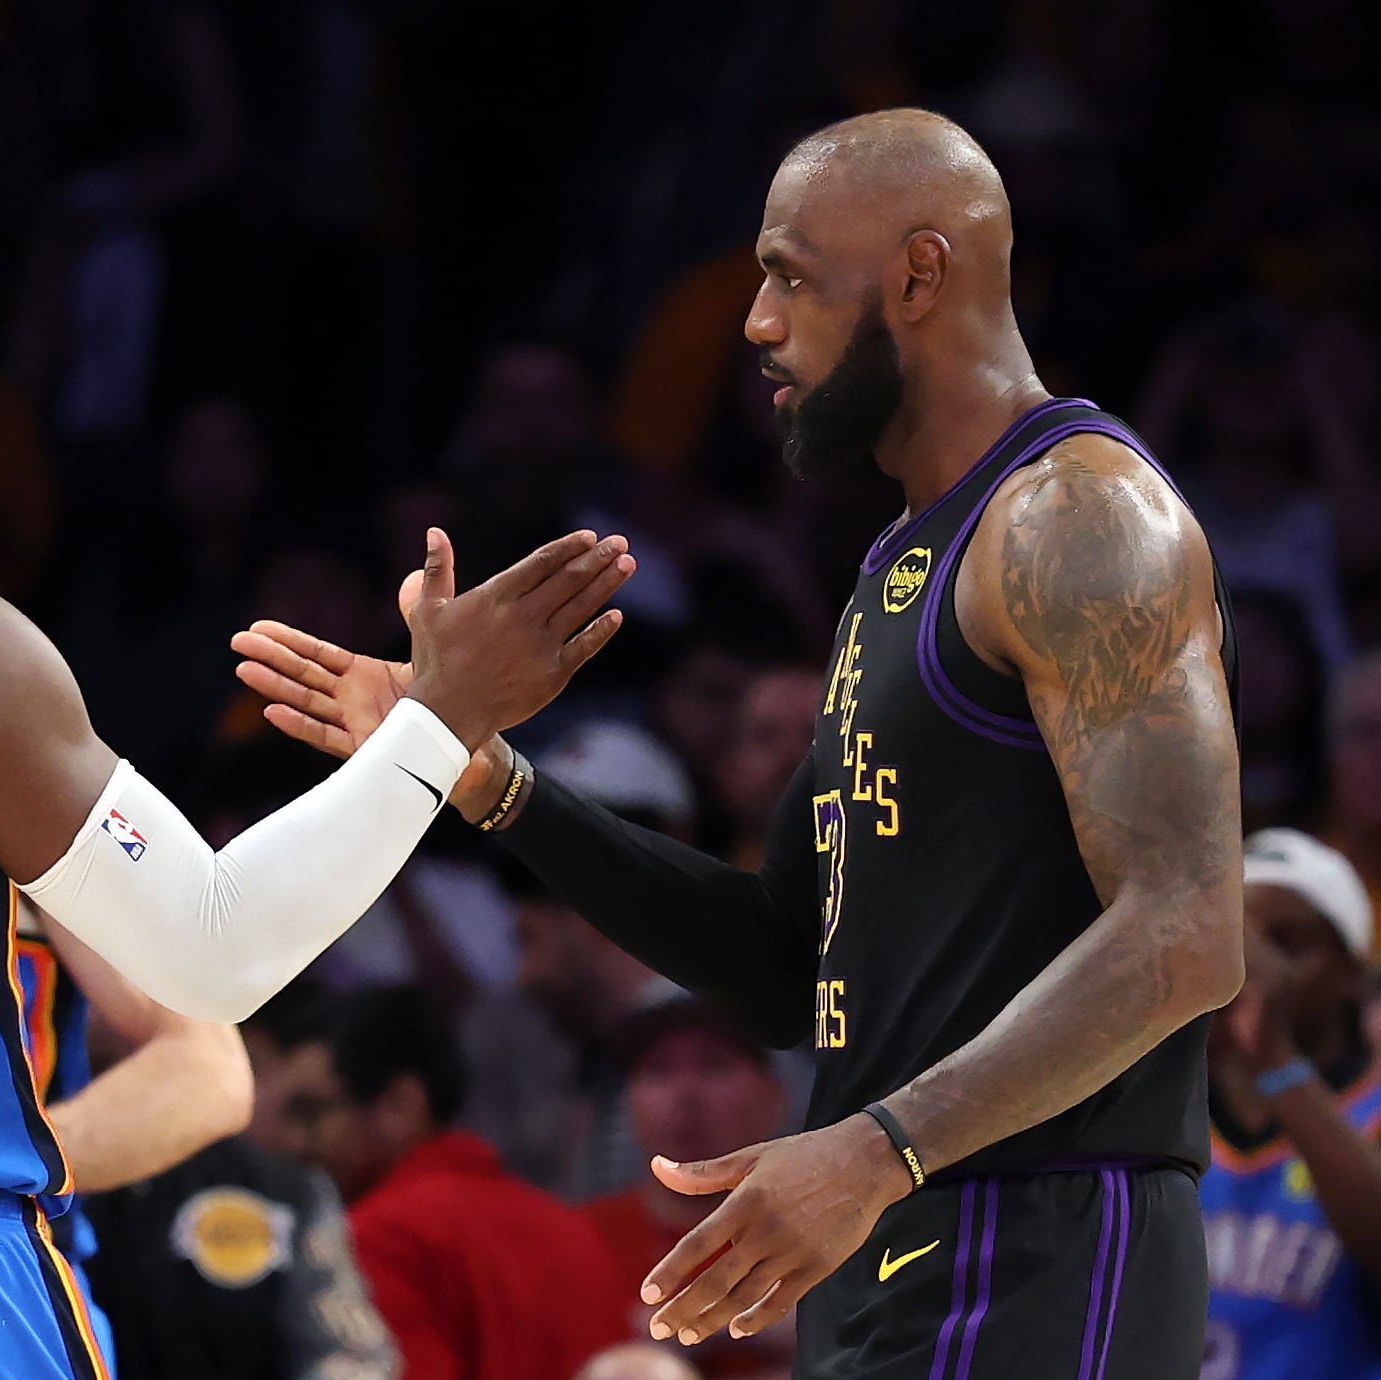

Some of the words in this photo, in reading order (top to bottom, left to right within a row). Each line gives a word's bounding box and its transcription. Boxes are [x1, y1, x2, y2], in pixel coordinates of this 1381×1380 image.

[889, 565, 926, 593] bibigo
[500, 769, 525, 812] AKRON
[813, 789, 846, 956] 3
[814, 979, 847, 1048] RS
